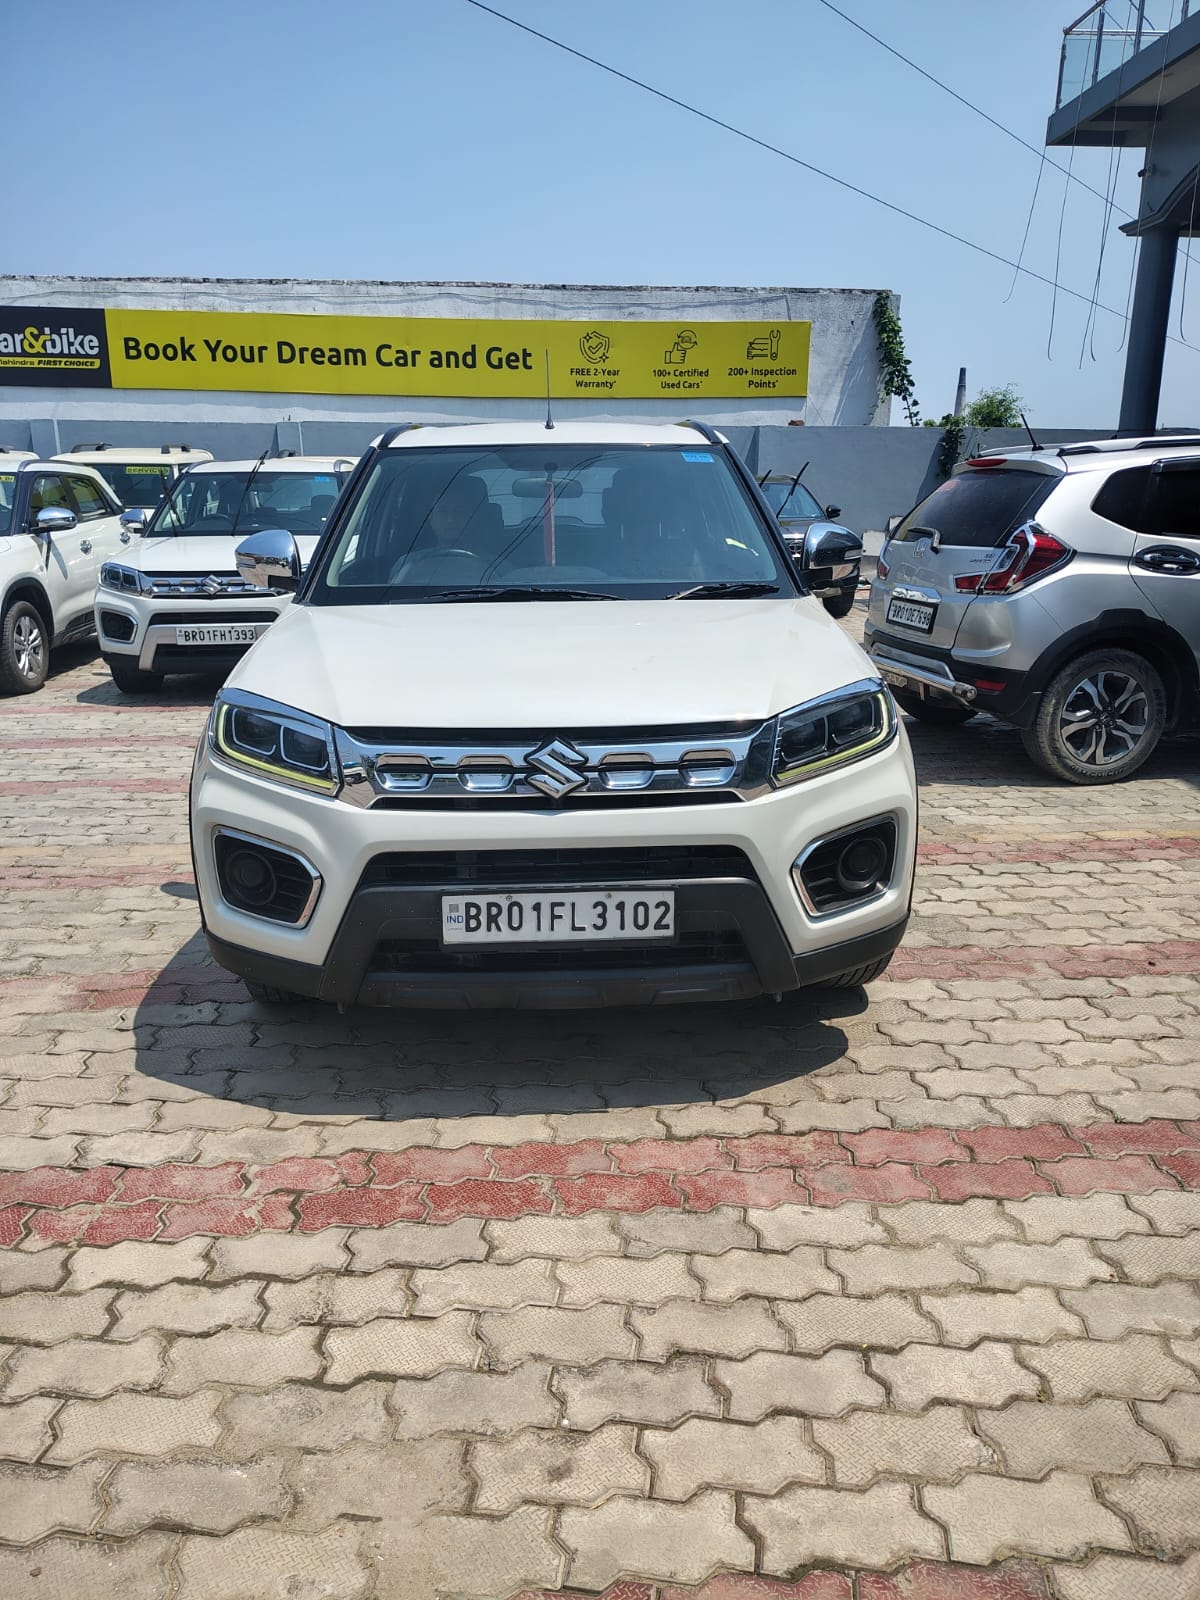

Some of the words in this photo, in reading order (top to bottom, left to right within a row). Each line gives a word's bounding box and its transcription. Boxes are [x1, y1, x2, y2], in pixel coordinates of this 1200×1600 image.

[123, 337, 197, 362] Book
[203, 339, 268, 363] Your
[277, 341, 367, 366] Dream
[376, 344, 421, 367] Car
[429, 344, 477, 369] and
[486, 346, 533, 370] Get
[38, 359, 62, 367] FIRST
[570, 367, 591, 376] FREE
[593, 367, 620, 376] 2-Year
[652, 369, 671, 377] 100+
[673, 369, 709, 377] Certified
[727, 367, 749, 376] 200+
[751, 366, 797, 377] Inspection
[661, 380, 680, 389] Used
[184, 629, 255, 642] BR01FH1393
[464, 900, 671, 933] BR01FL3102
